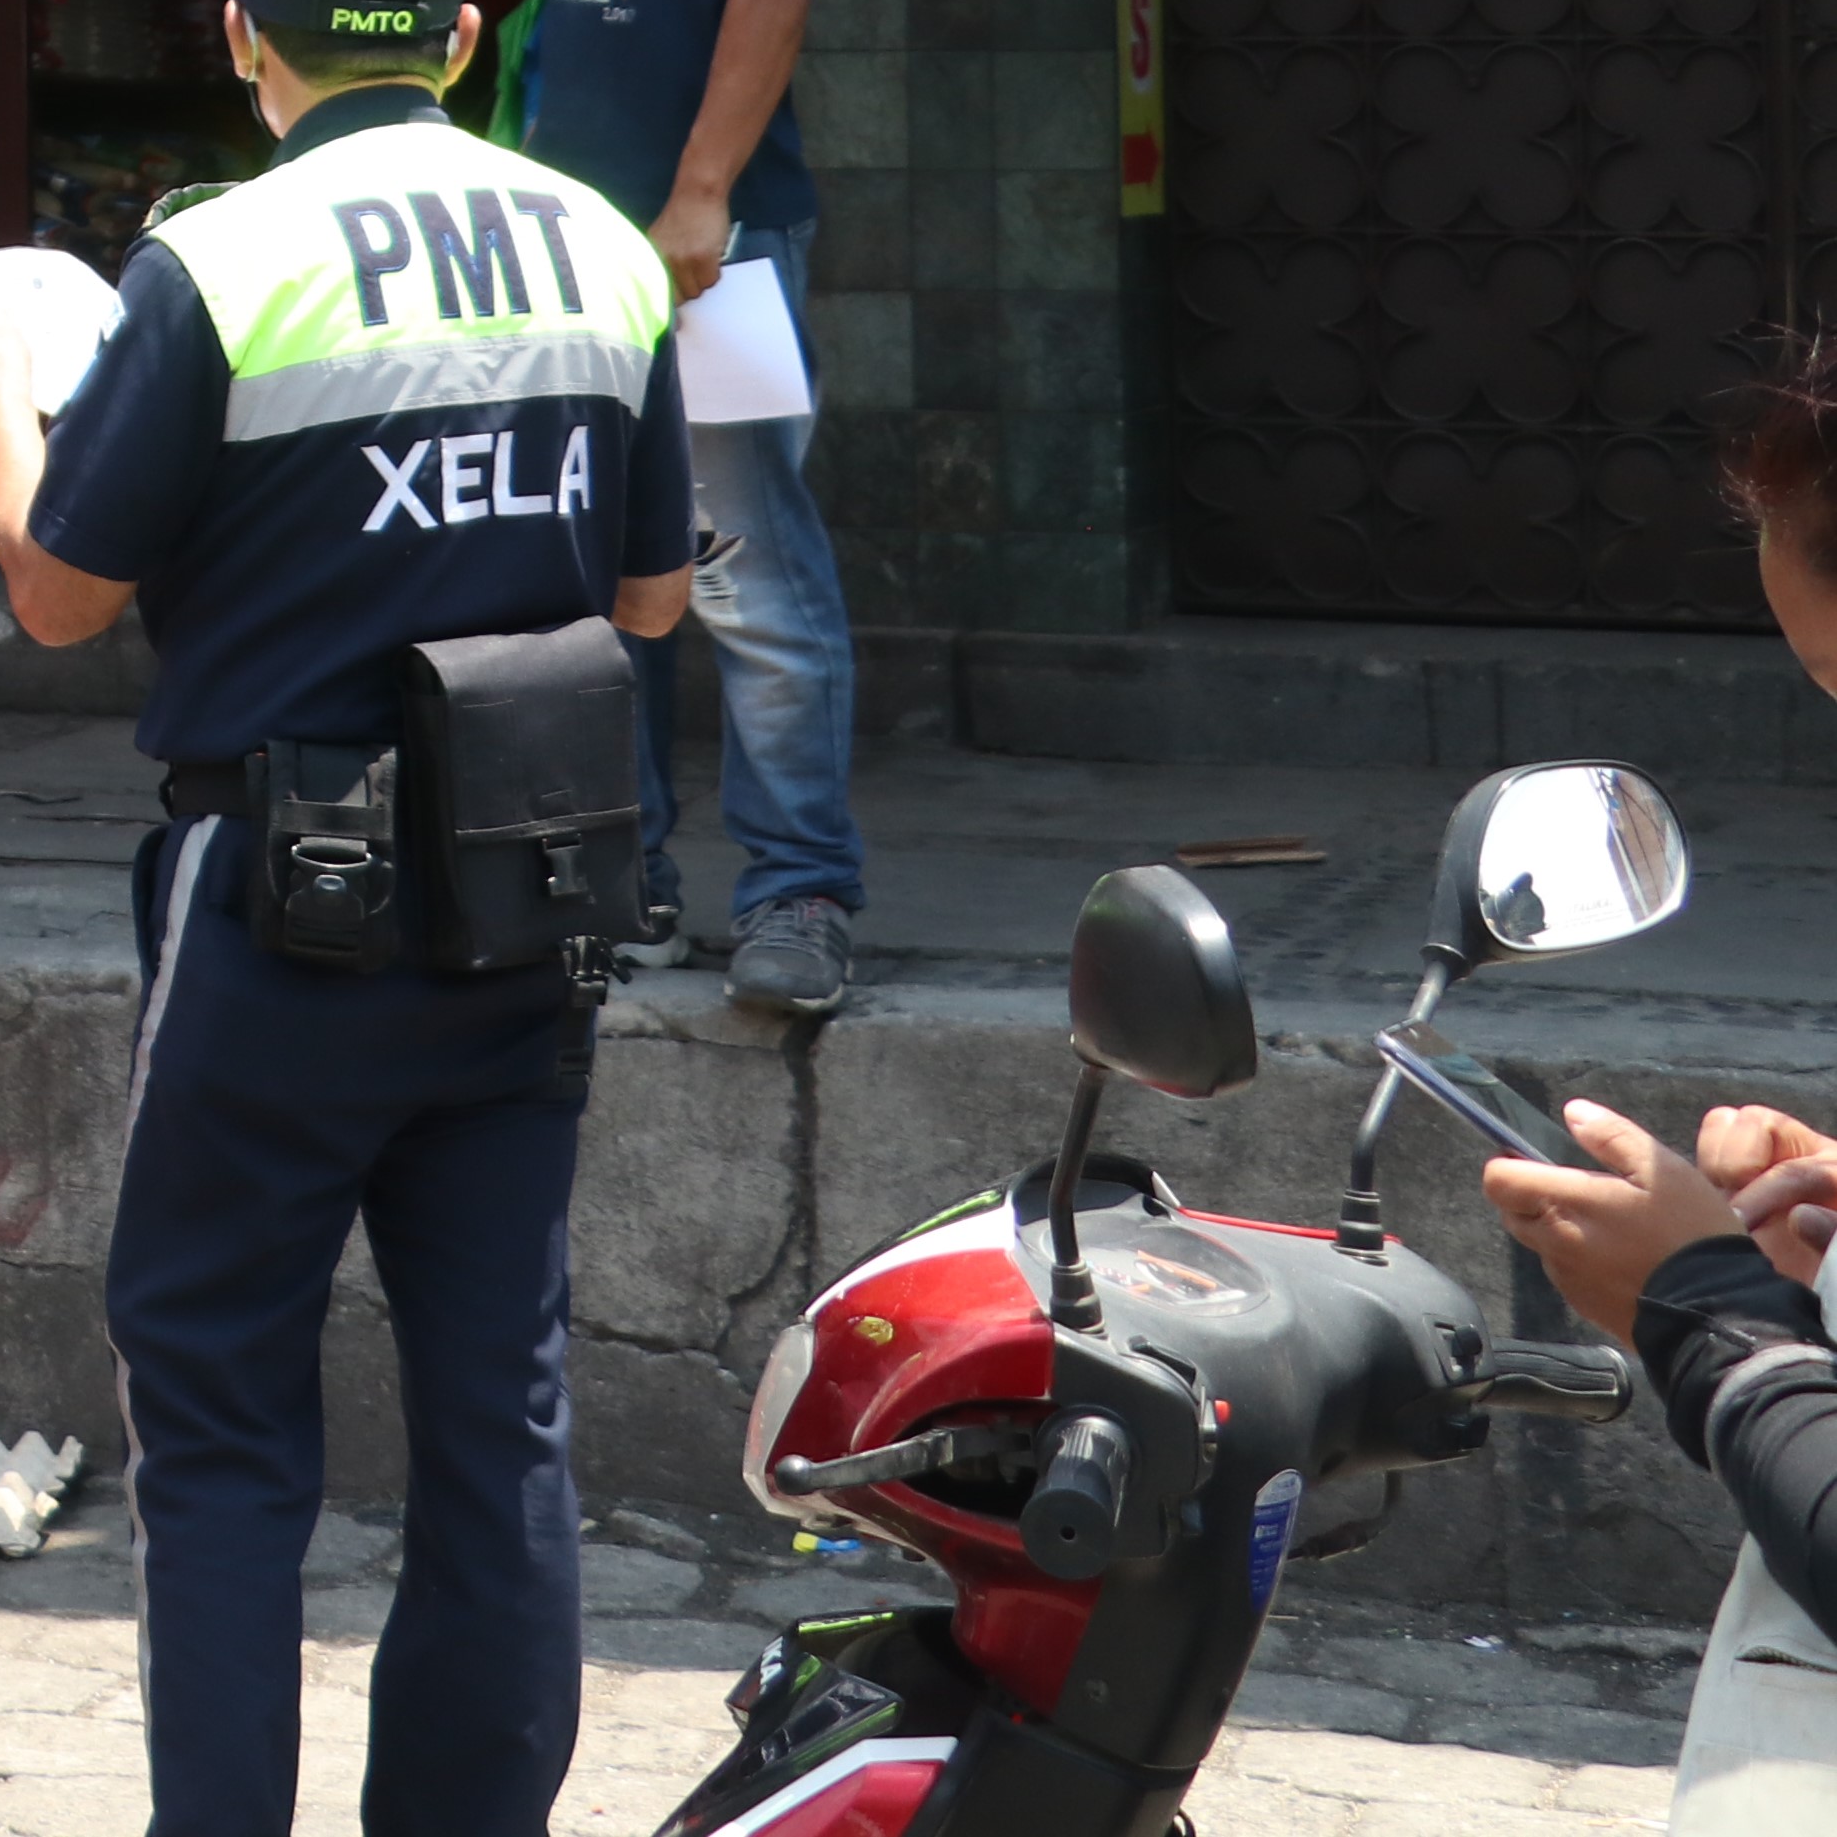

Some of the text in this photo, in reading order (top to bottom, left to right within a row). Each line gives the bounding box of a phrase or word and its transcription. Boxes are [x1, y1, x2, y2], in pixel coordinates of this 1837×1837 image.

[329, 5, 414, 35] PMTQ
[331, 187, 585, 327] PMT
[359, 424, 591, 534] XELA
